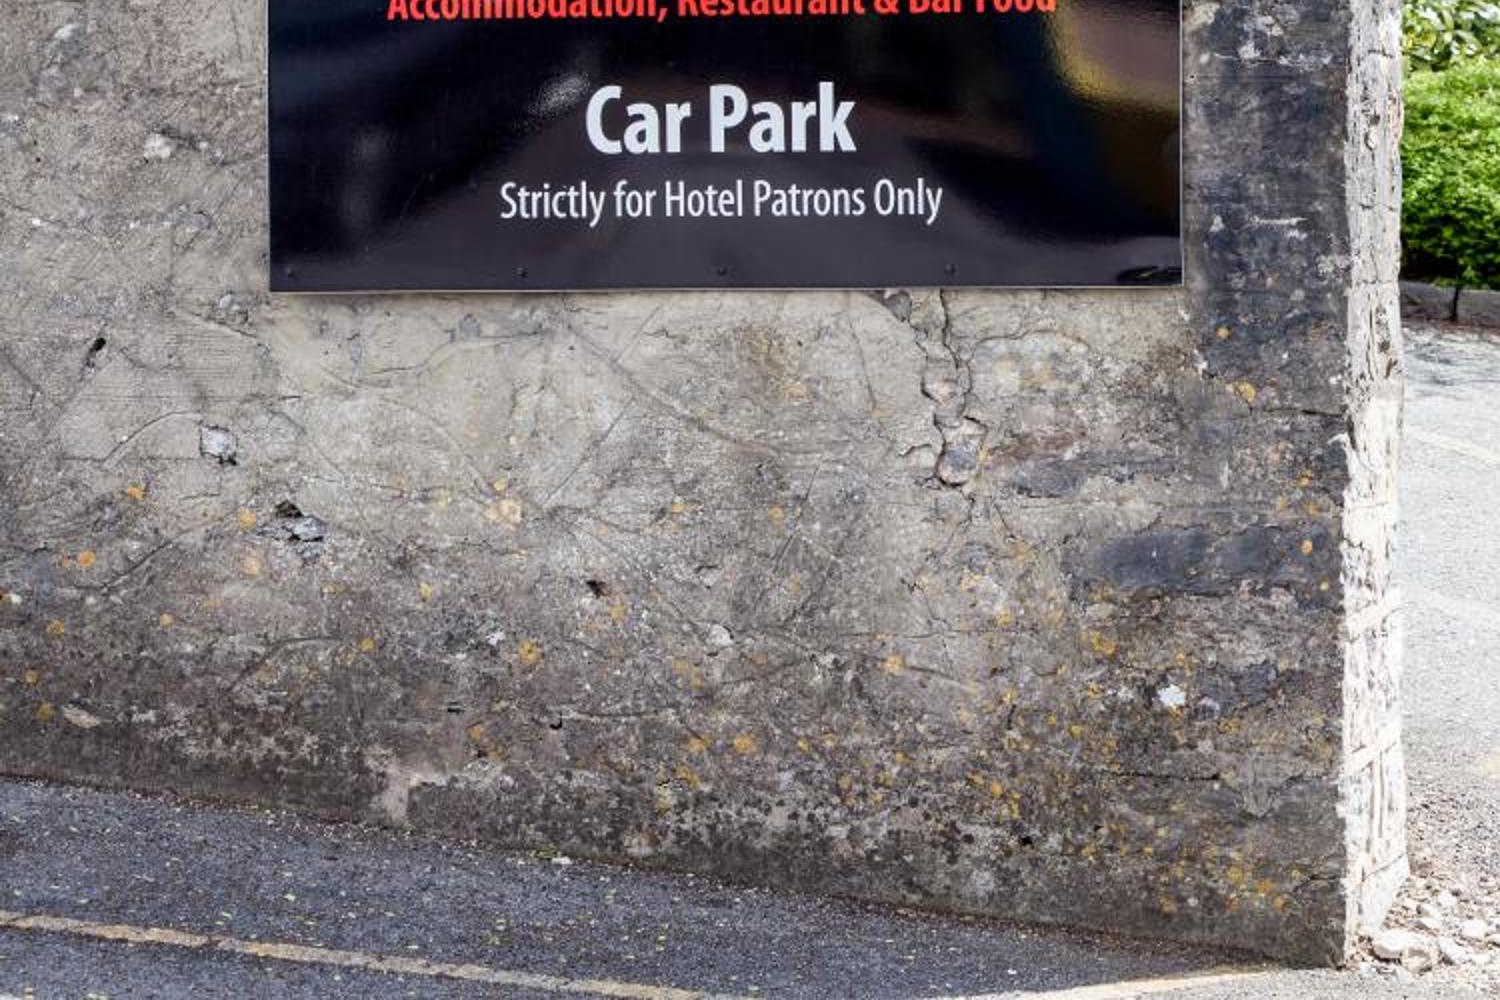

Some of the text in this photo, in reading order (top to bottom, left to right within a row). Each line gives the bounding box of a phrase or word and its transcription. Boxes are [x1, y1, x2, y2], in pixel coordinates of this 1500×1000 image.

[585, 81, 857, 155] Car Park
[500, 177, 943, 228] Strictly for Hotel Patrons Only
